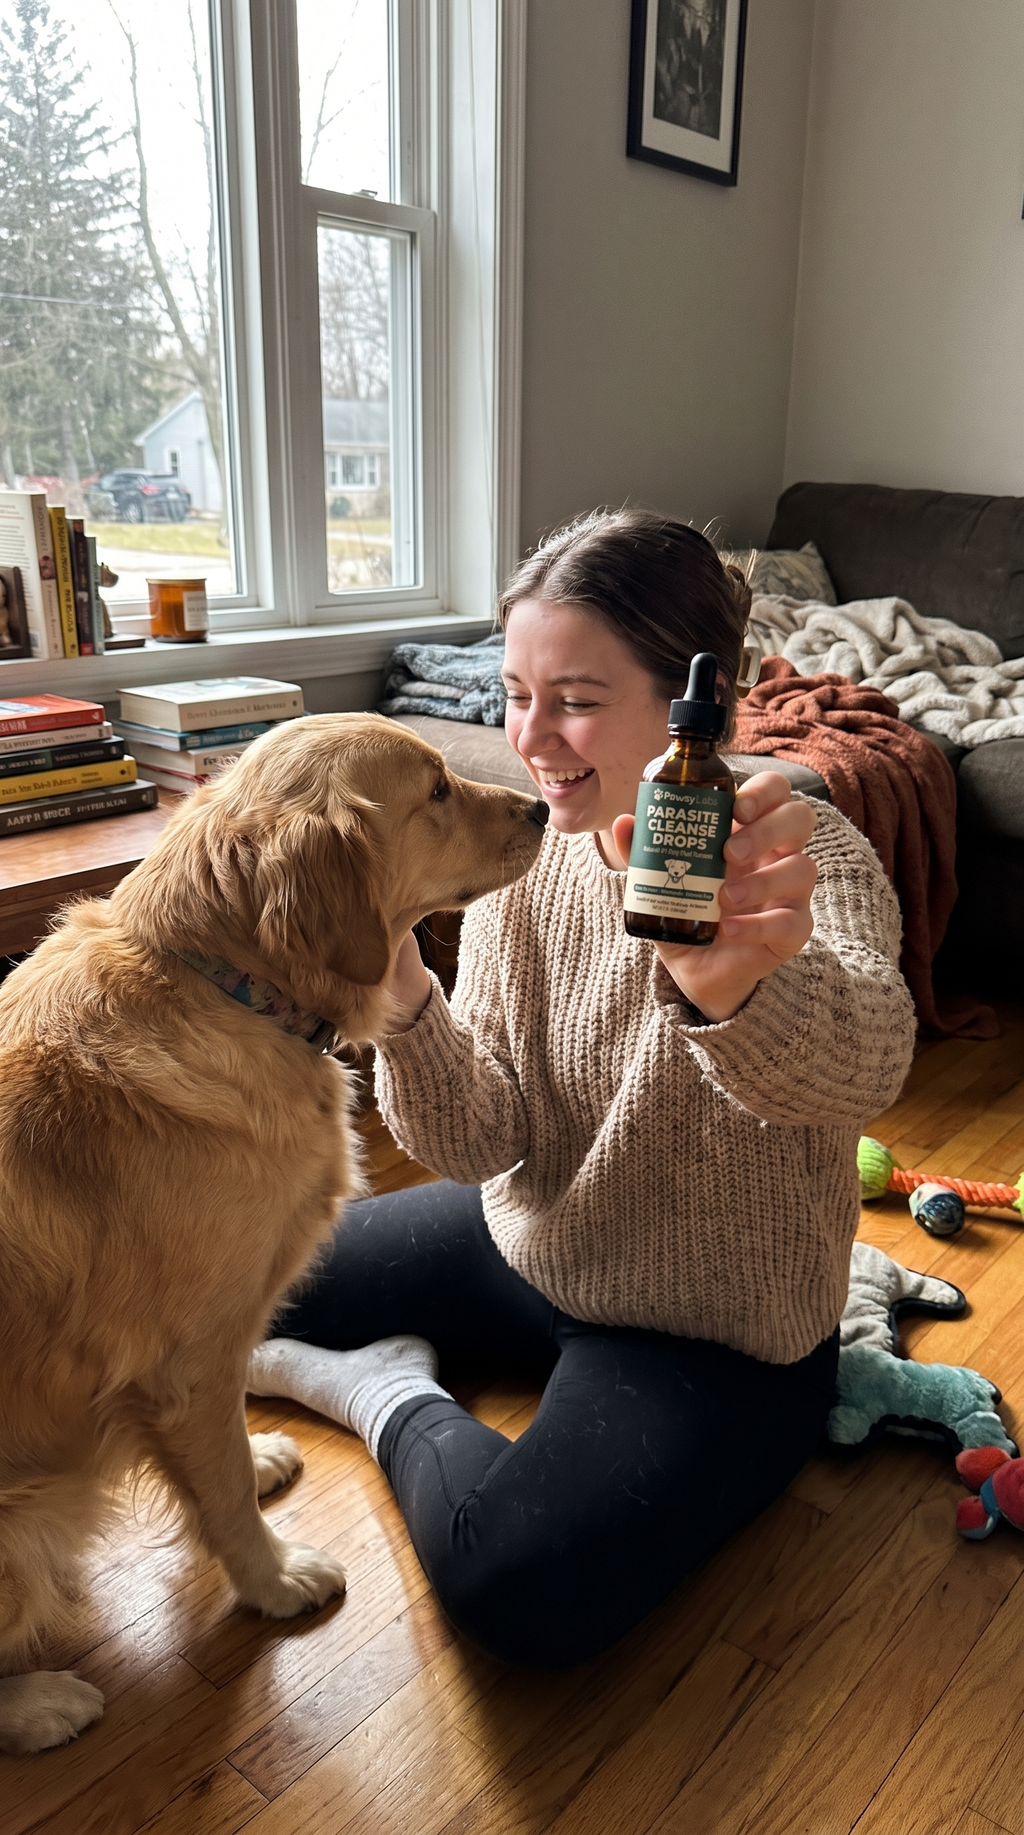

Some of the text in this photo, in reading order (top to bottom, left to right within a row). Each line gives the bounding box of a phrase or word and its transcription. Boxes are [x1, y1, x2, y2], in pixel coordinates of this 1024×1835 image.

[664, 791, 719, 806] Pawsy Labs
[647, 805, 720, 825] PARASITE
[648, 819, 717, 838] CLEANSE
[652, 833, 707, 850] DROPS
